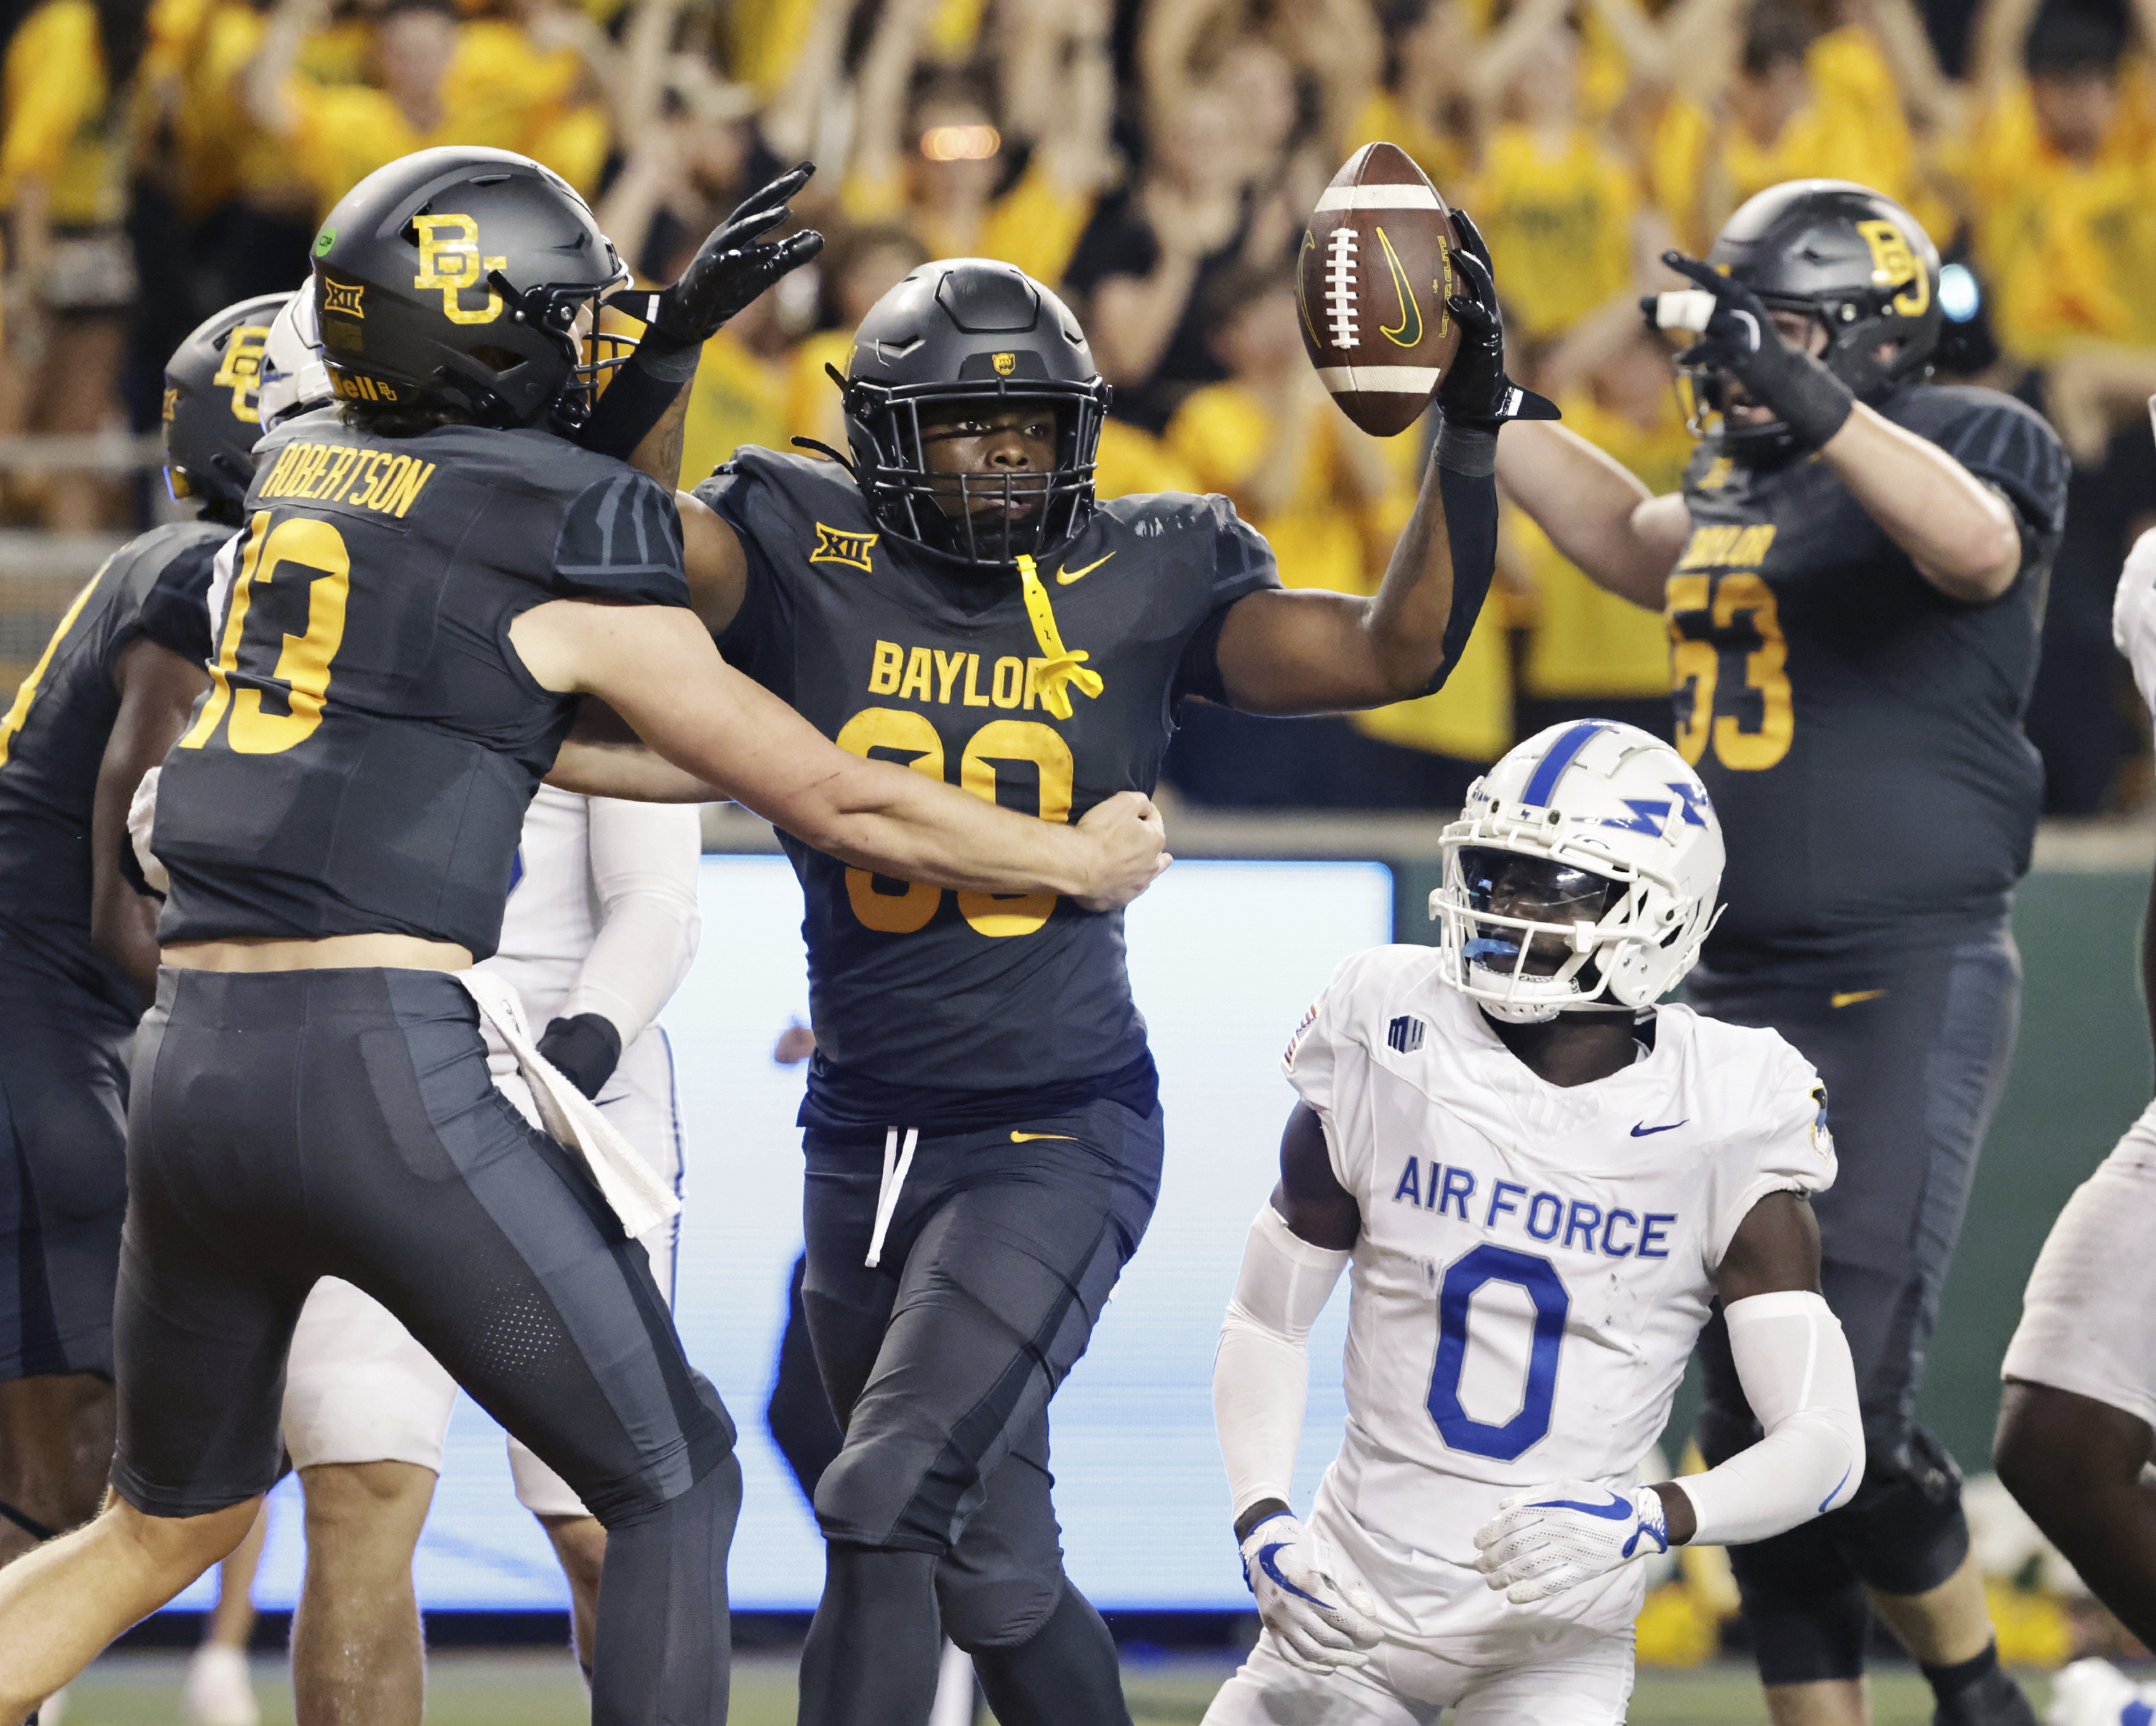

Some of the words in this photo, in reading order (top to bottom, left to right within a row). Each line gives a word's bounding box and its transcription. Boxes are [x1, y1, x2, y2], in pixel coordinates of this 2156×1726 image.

[413, 214, 507, 325] BU
[258, 442, 436, 518] ROBERTSON
[178, 511, 351, 755] 13
[1665, 572, 1795, 771] 53
[1392, 1155, 1478, 1223] AIR
[1483, 1177, 1679, 1260] FORCE
[1423, 1240, 1573, 1466] 0
